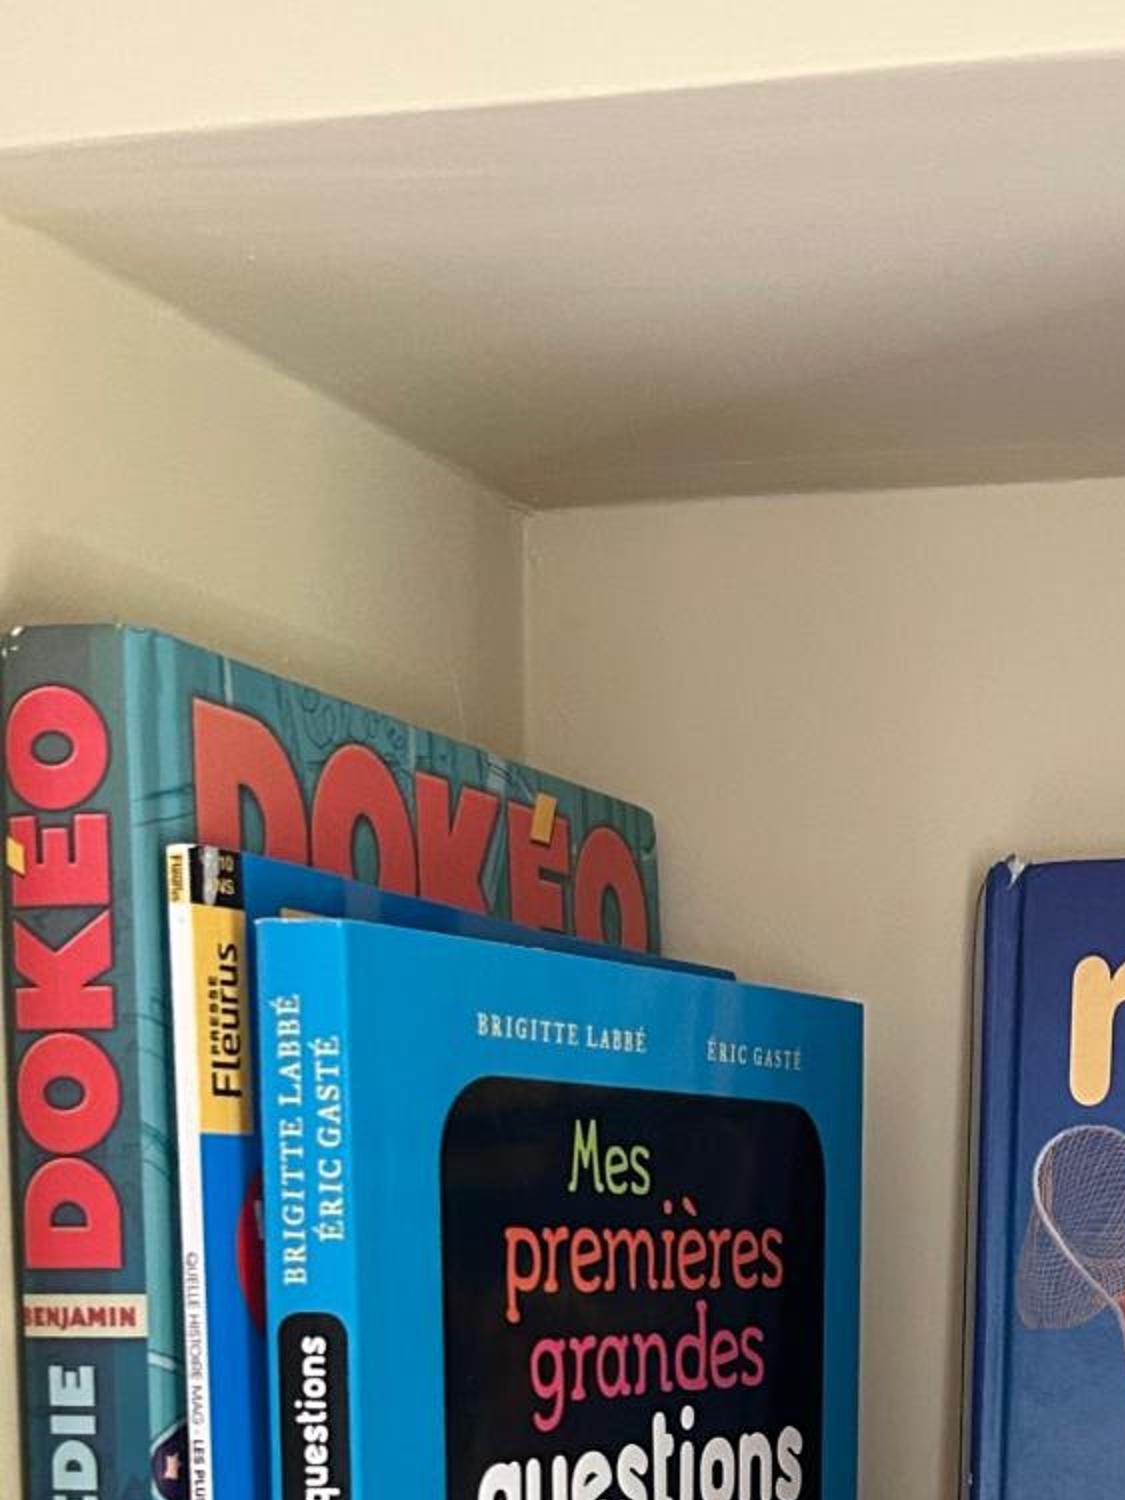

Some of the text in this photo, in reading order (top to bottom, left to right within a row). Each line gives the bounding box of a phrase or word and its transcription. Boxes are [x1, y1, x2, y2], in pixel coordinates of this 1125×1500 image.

[6, 684, 124, 1269] DOKÉO
[208, 975, 220, 1055] PRESSE
[211, 943, 243, 1098] Fleurus
[476, 1012, 648, 1053] BRIGITTE LABBÉ
[706, 1037, 801, 1072] ÉRIC GASTÉ
[270, 994, 308, 1286] BRIGITTE LABBÉ
[307, 1034, 345, 1242] ÉRIC GASTÉ
[568, 1119, 650, 1195] Mes
[186, 1252, 200, 1309] QUELLE
[504, 1198, 783, 1323] premières
[22, 1305, 136, 1330] BENJAMIN
[188, 1313, 203, 1377] HISTOIRE
[191, 1385, 205, 1425] MAG
[530, 1301, 764, 1433] grandes
[193, 1439, 206, 1465] LES
